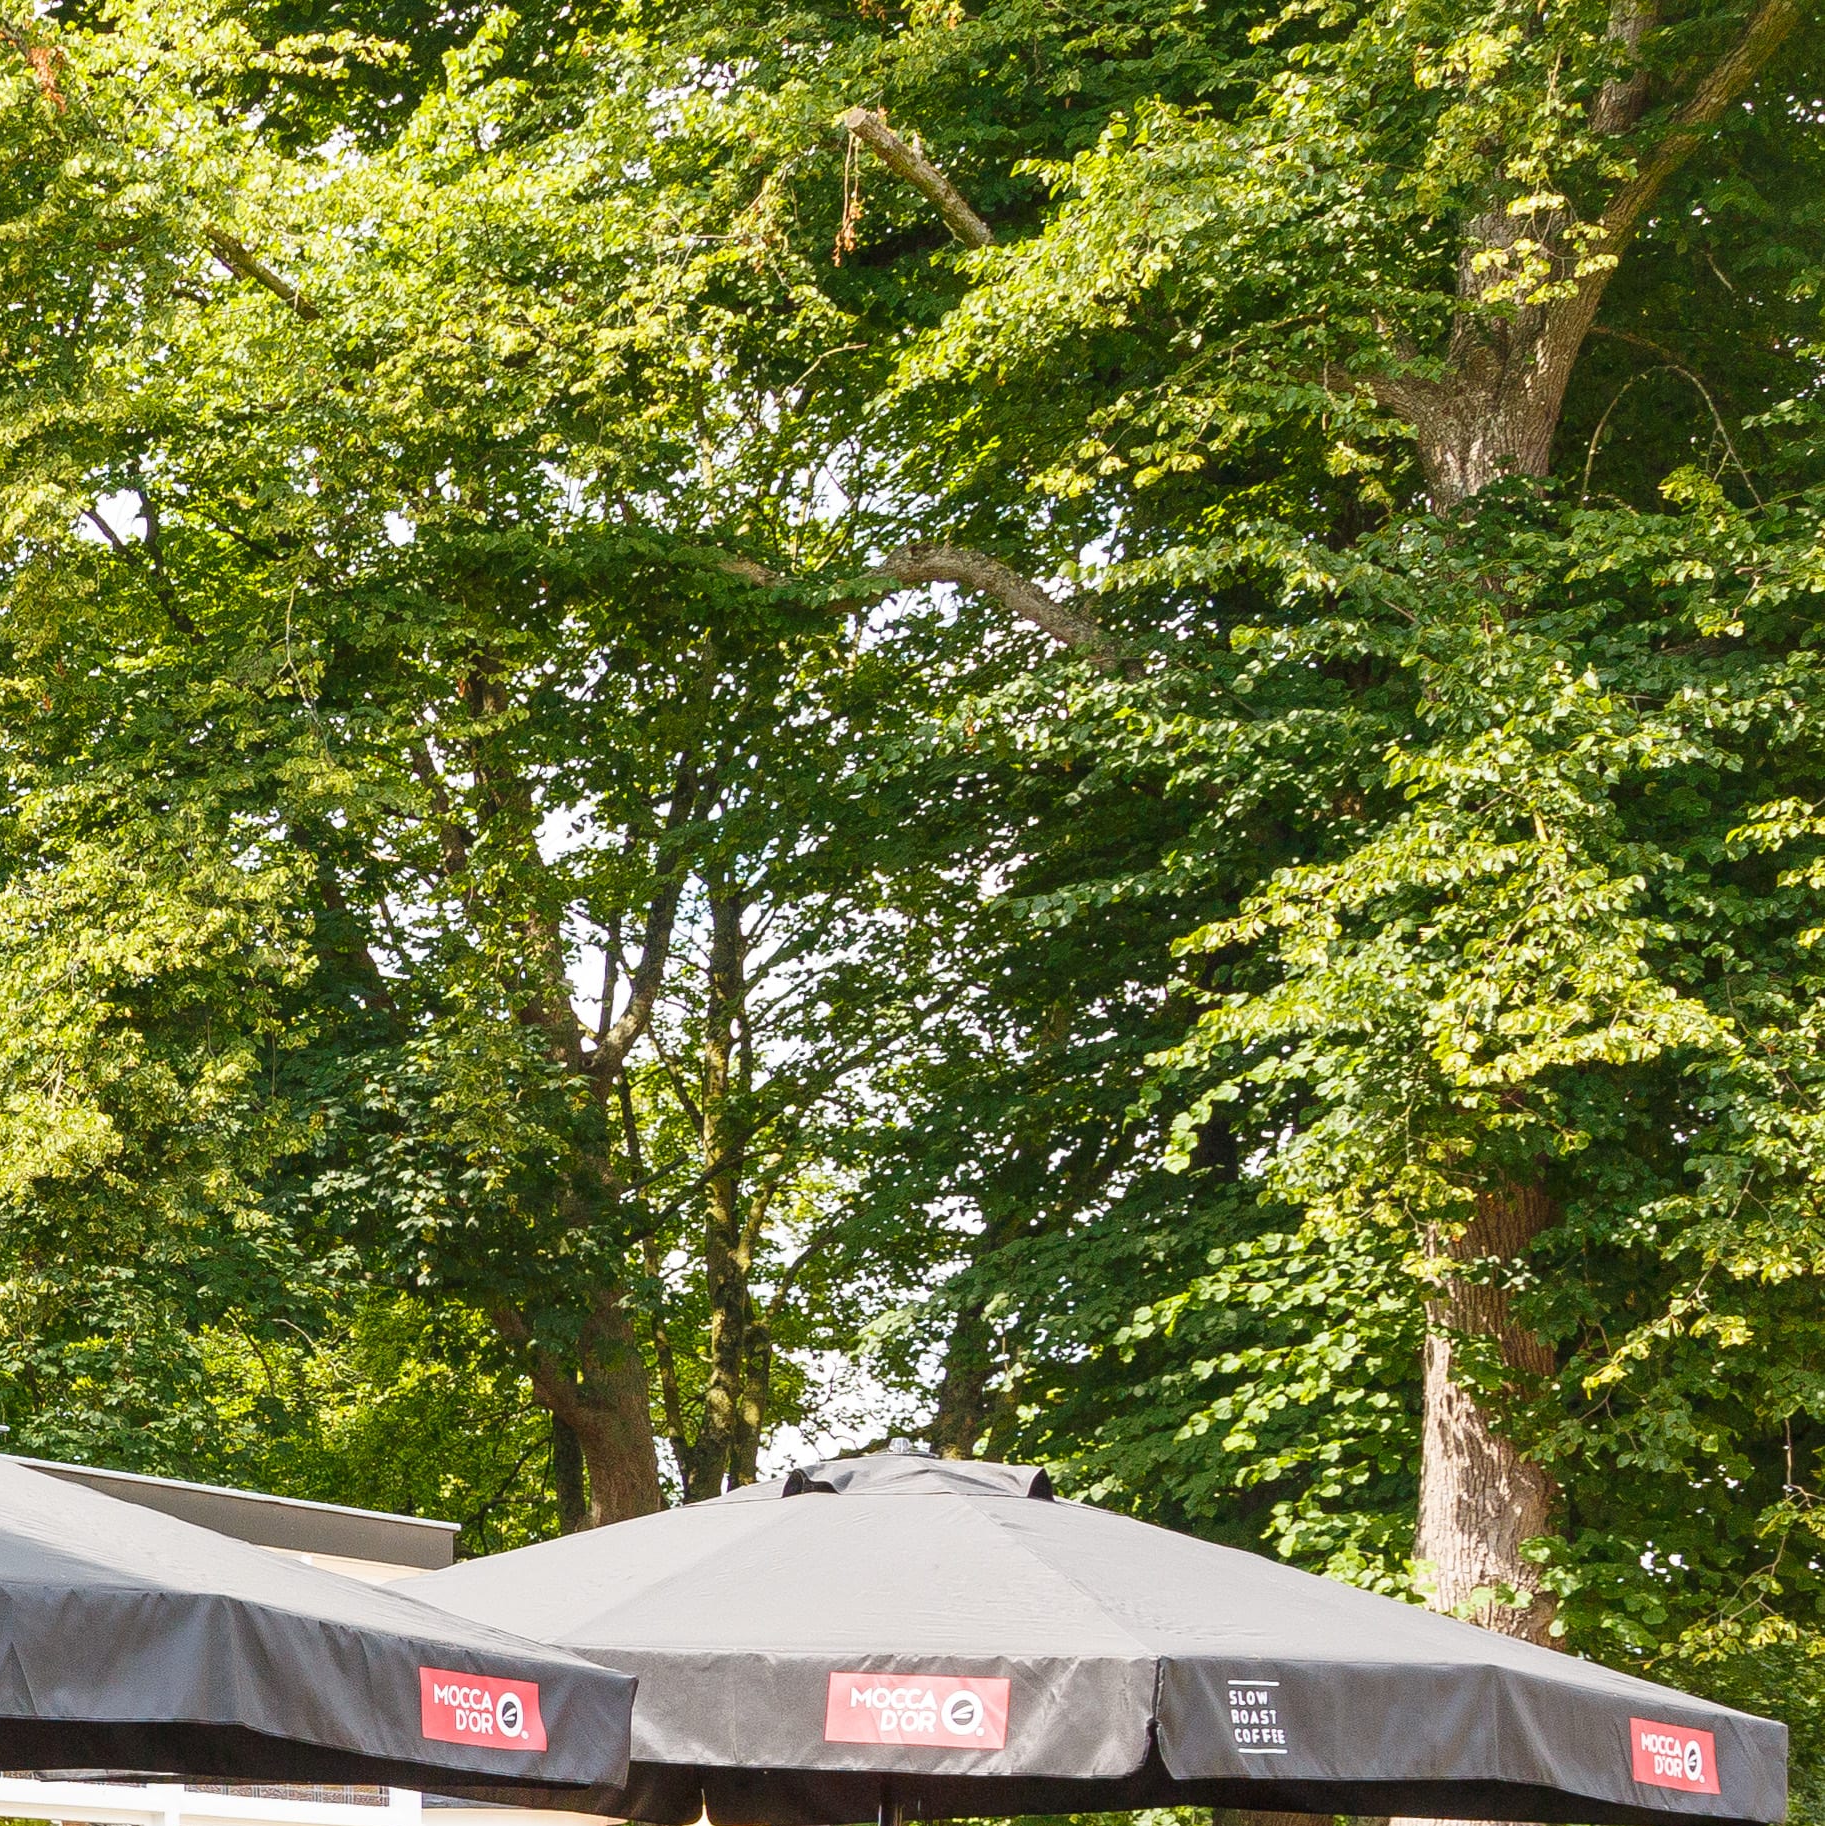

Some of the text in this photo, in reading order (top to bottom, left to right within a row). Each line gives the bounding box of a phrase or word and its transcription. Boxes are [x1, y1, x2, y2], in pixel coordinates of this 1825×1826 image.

[433, 1683, 493, 1712] MOCCA
[850, 1687, 938, 1710] MOCCA
[1229, 1690, 1268, 1705] SLOW
[455, 1709, 493, 1735] D'OR
[880, 1709, 937, 1733] D'OR
[1231, 1709, 1277, 1725] ROAST
[1234, 1728, 1286, 1744] COFFEE
[1640, 1732, 1683, 1758] MOCCA
[1654, 1755, 1683, 1778] D'OR
